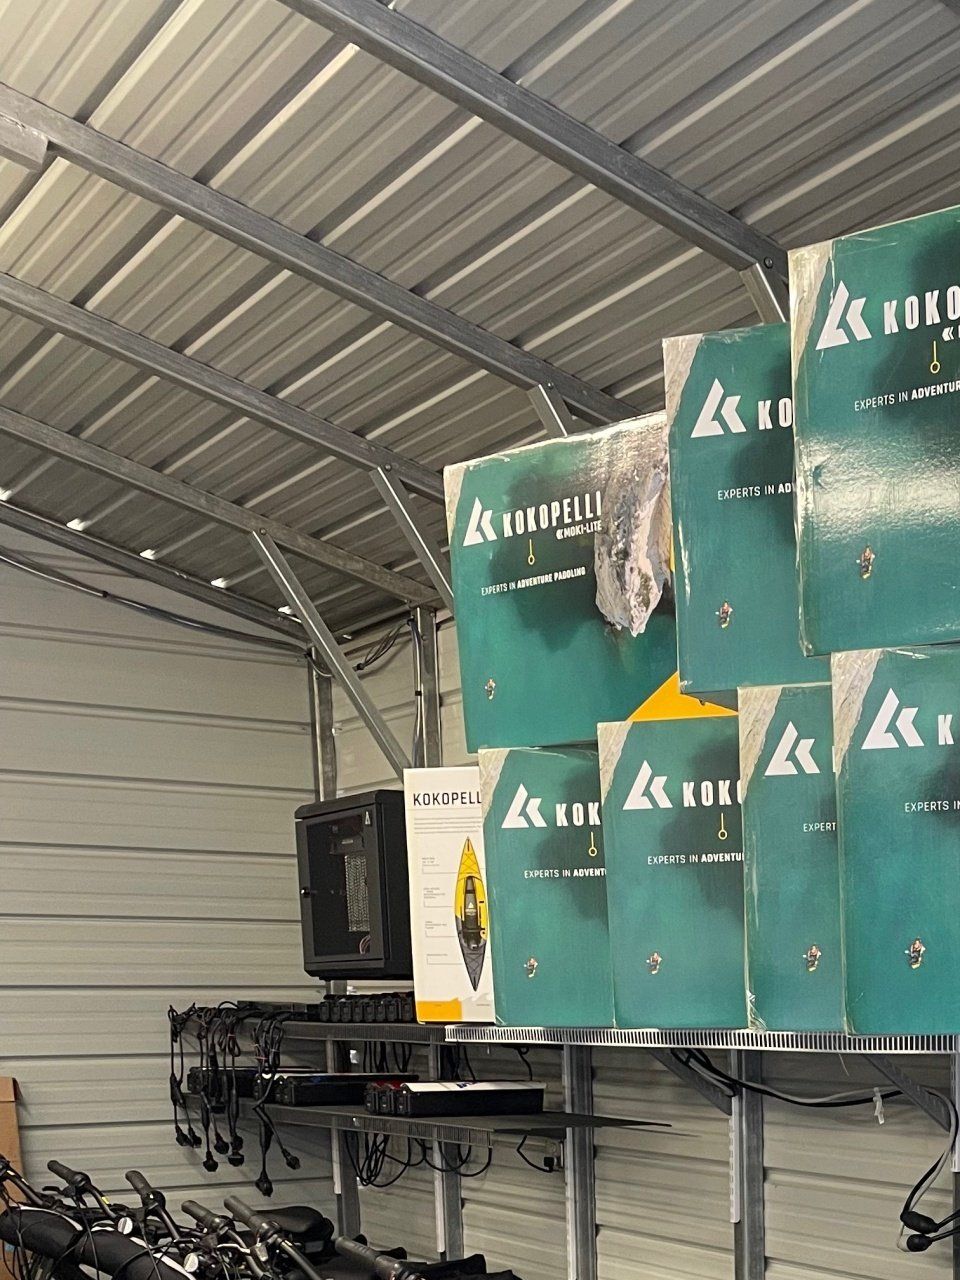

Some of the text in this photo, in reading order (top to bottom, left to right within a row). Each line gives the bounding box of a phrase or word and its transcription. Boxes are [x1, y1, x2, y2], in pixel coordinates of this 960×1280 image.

[855, 391, 896, 411] EXPERTS
[898, 389, 909, 401] IN
[758, 398, 792, 431] KO
[717, 487, 761, 501] EXPERTS
[764, 485, 776, 495] IN
[502, 491, 602, 538] KOKOPELLI
[563, 521, 602, 539] MOKI-LITE
[481, 566, 586, 596] EXPERTS IN ADVENTURE PADDLING
[556, 802, 601, 827] KOK
[904, 800, 950, 812] EXPERTS
[648, 854, 686, 864] EXPERTS
[689, 854, 698, 862] IN
[524, 869, 560, 879] EXPERTS
